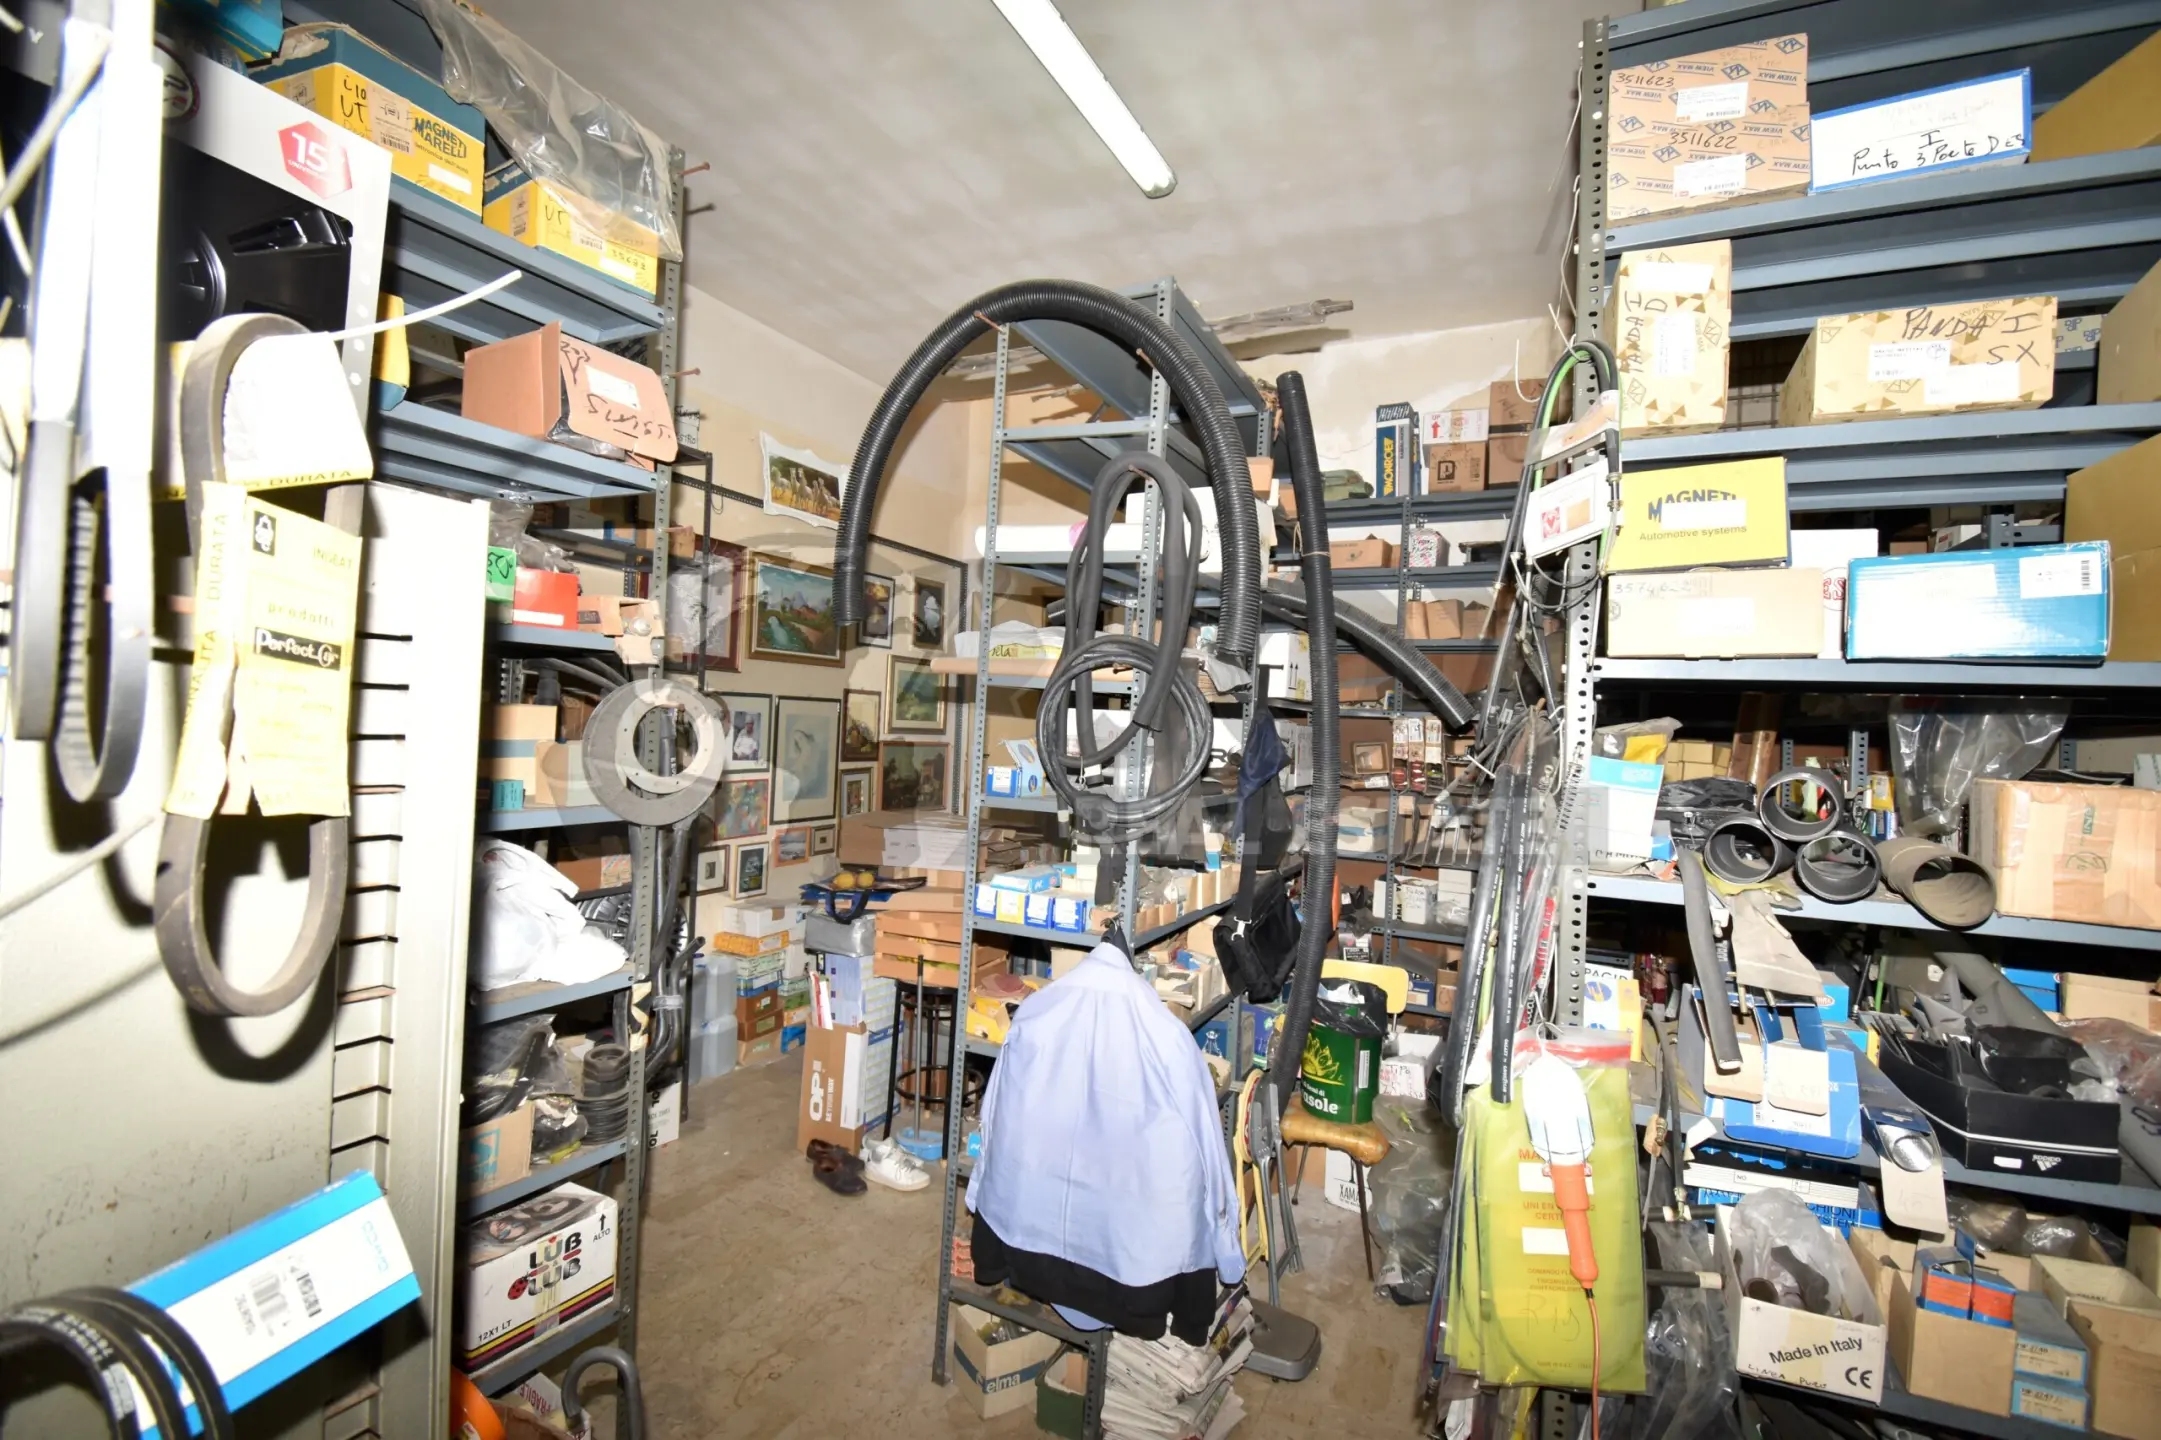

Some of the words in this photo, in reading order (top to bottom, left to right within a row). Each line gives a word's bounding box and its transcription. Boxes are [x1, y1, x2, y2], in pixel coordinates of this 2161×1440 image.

[1615, 72, 1675, 88] 3511623
[1668, 131, 1739, 149] 3511622
[1902, 307, 1990, 340] PANDA
[1383, 442, 1394, 491] MONROE
[1639, 530, 1699, 542] Automotive
[1701, 525, 1748, 537] systems
[1822, 577, 1846, 601] ES
[592, 1228, 611, 1243] ALTO
[529, 1231, 582, 1269] LUB
[528, 1257, 582, 1296] LUB
[478, 1326, 499, 1342] 12X1
[501, 1319, 512, 1331] LT
[1768, 1348, 1812, 1364] Made
[1813, 1344, 1829, 1356] in
[1829, 1337, 1863, 1353] Italy
[986, 1373, 1021, 1394] elma
[1844, 1366, 1873, 1390] CE
[519, 1382, 552, 1414] FRAGILE
